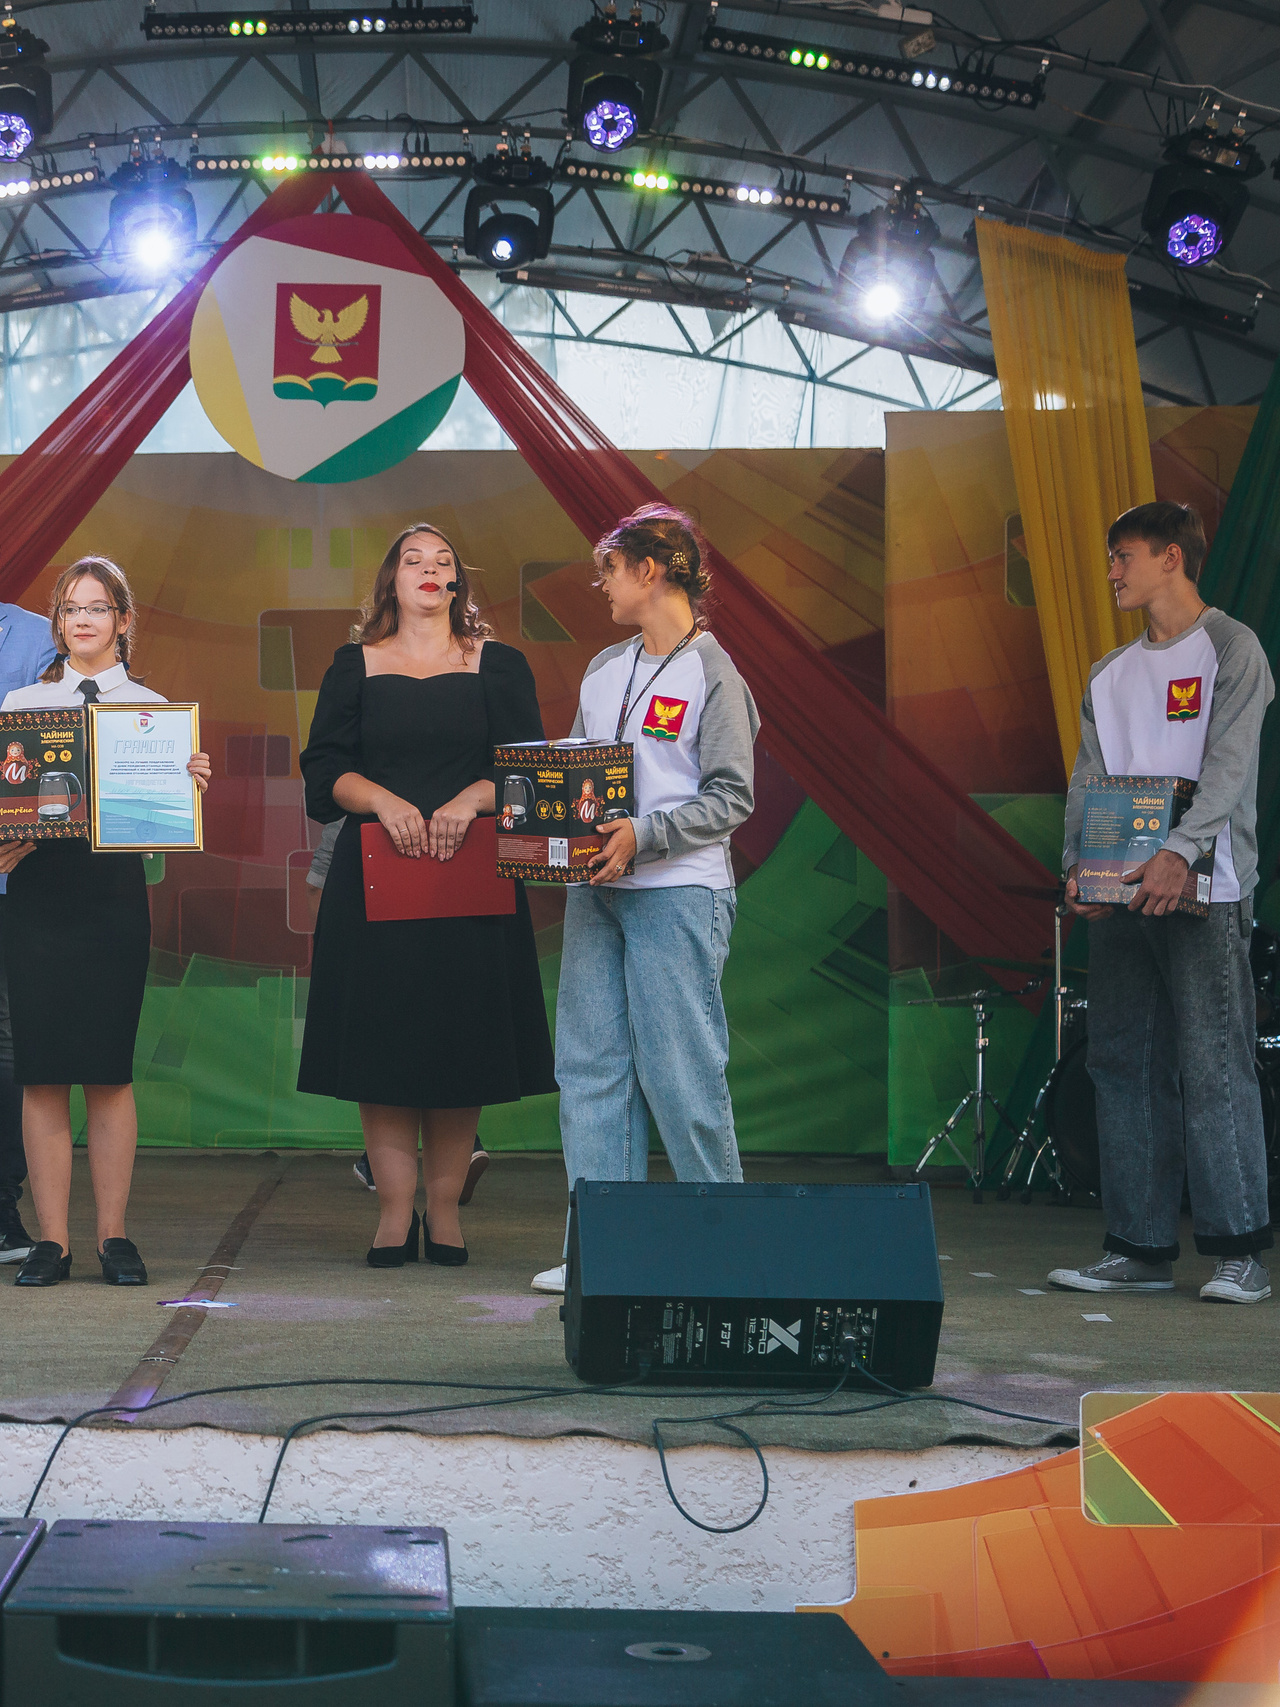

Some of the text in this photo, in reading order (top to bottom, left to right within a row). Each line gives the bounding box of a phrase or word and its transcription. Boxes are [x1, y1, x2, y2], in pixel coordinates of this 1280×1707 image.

[40, 731, 74, 739] ЧАЙНИК
[114, 739, 175, 754] ГРАМОТА
[537, 770, 564, 779] ЧАЙНИК
[605, 766, 628, 775] ЧАЙНИК
[1132, 796, 1165, 805] ЧАЙНИК
[1080, 868, 1120, 878] Матрёна
[720, 1322, 732, 1349] FBT
[758, 1317, 769, 1354] PRO
